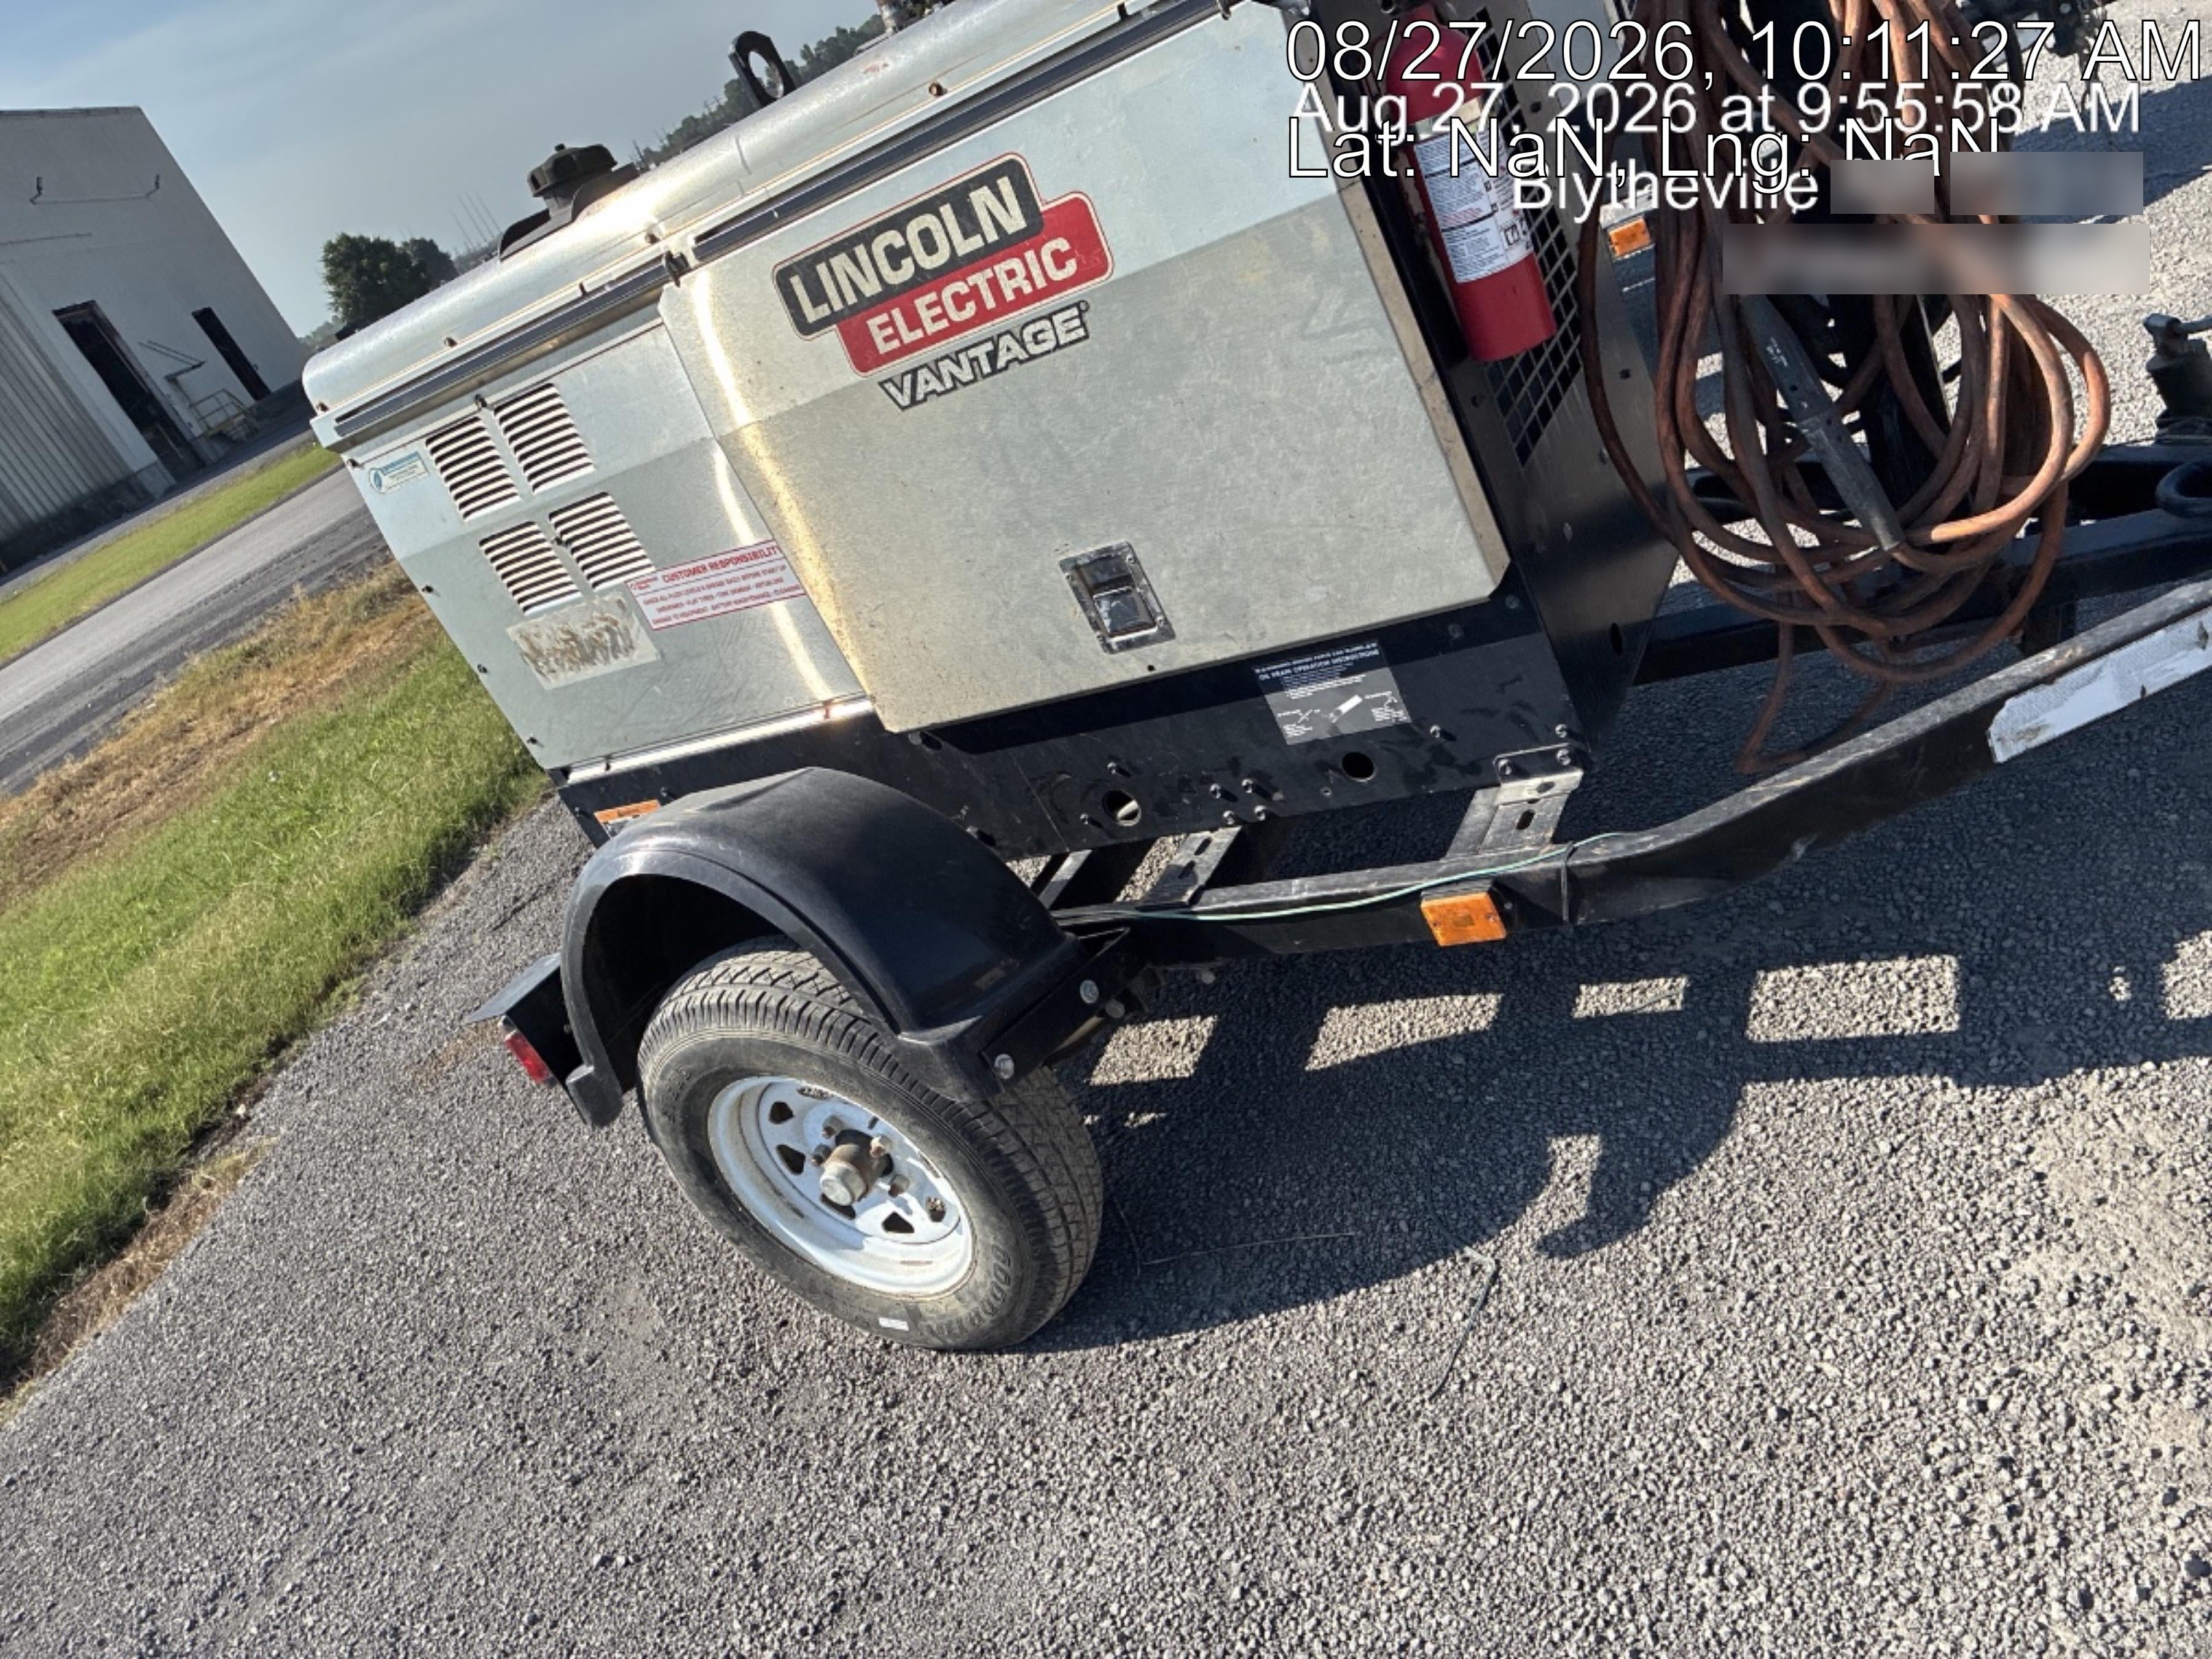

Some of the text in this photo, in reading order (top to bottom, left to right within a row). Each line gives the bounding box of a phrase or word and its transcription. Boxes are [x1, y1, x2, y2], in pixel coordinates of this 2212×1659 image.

[790, 176, 1028, 324] LINCOLN
[866, 236, 1077, 355] ELECTRIC
[662, 546, 779, 582] CUSTOMER RESPONSIBILIT
